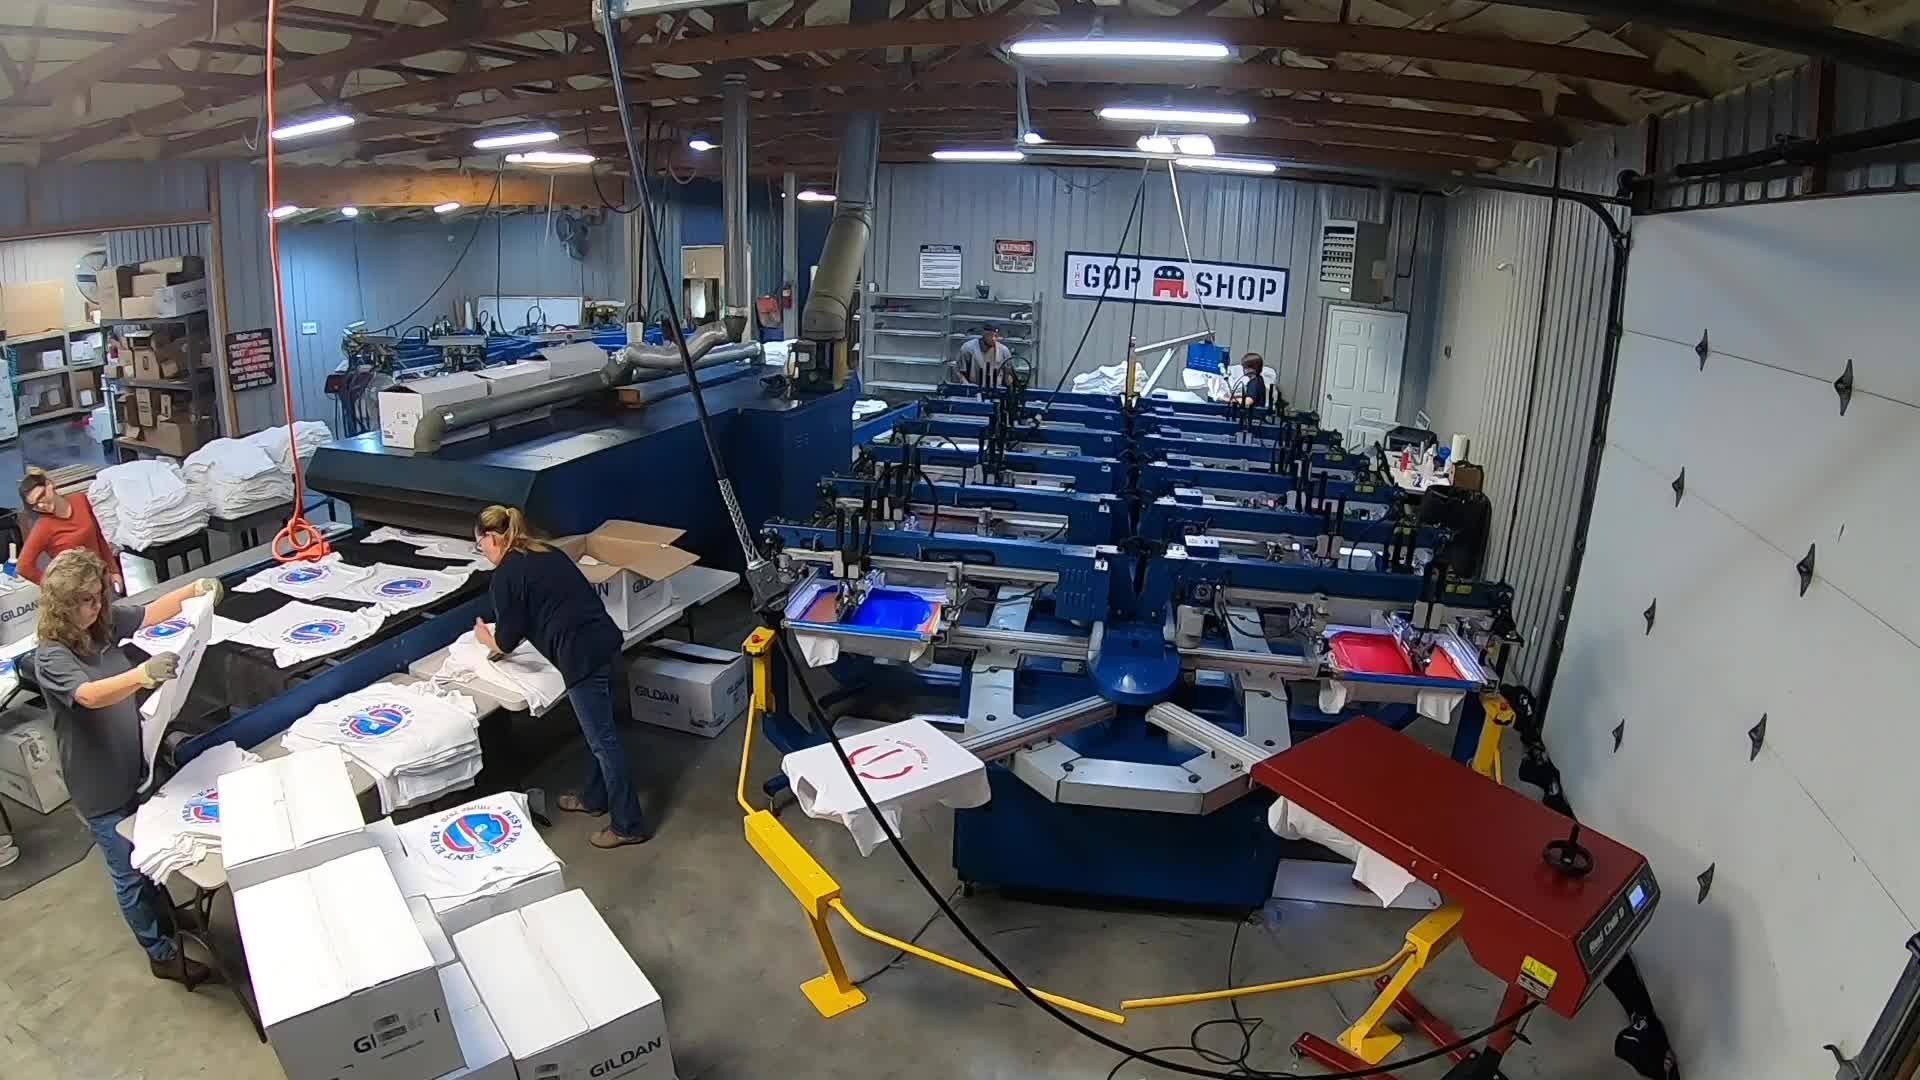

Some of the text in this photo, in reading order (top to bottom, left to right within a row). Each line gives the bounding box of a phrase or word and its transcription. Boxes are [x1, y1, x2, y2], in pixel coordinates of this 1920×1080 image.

[1073, 263, 1277, 303] THE GOP SHOP
[634, 685, 680, 704] GILDAN
[502, 809, 523, 830] BEST
[429, 830, 447, 855] EVER
[589, 1035, 662, 1078] GILDAN
